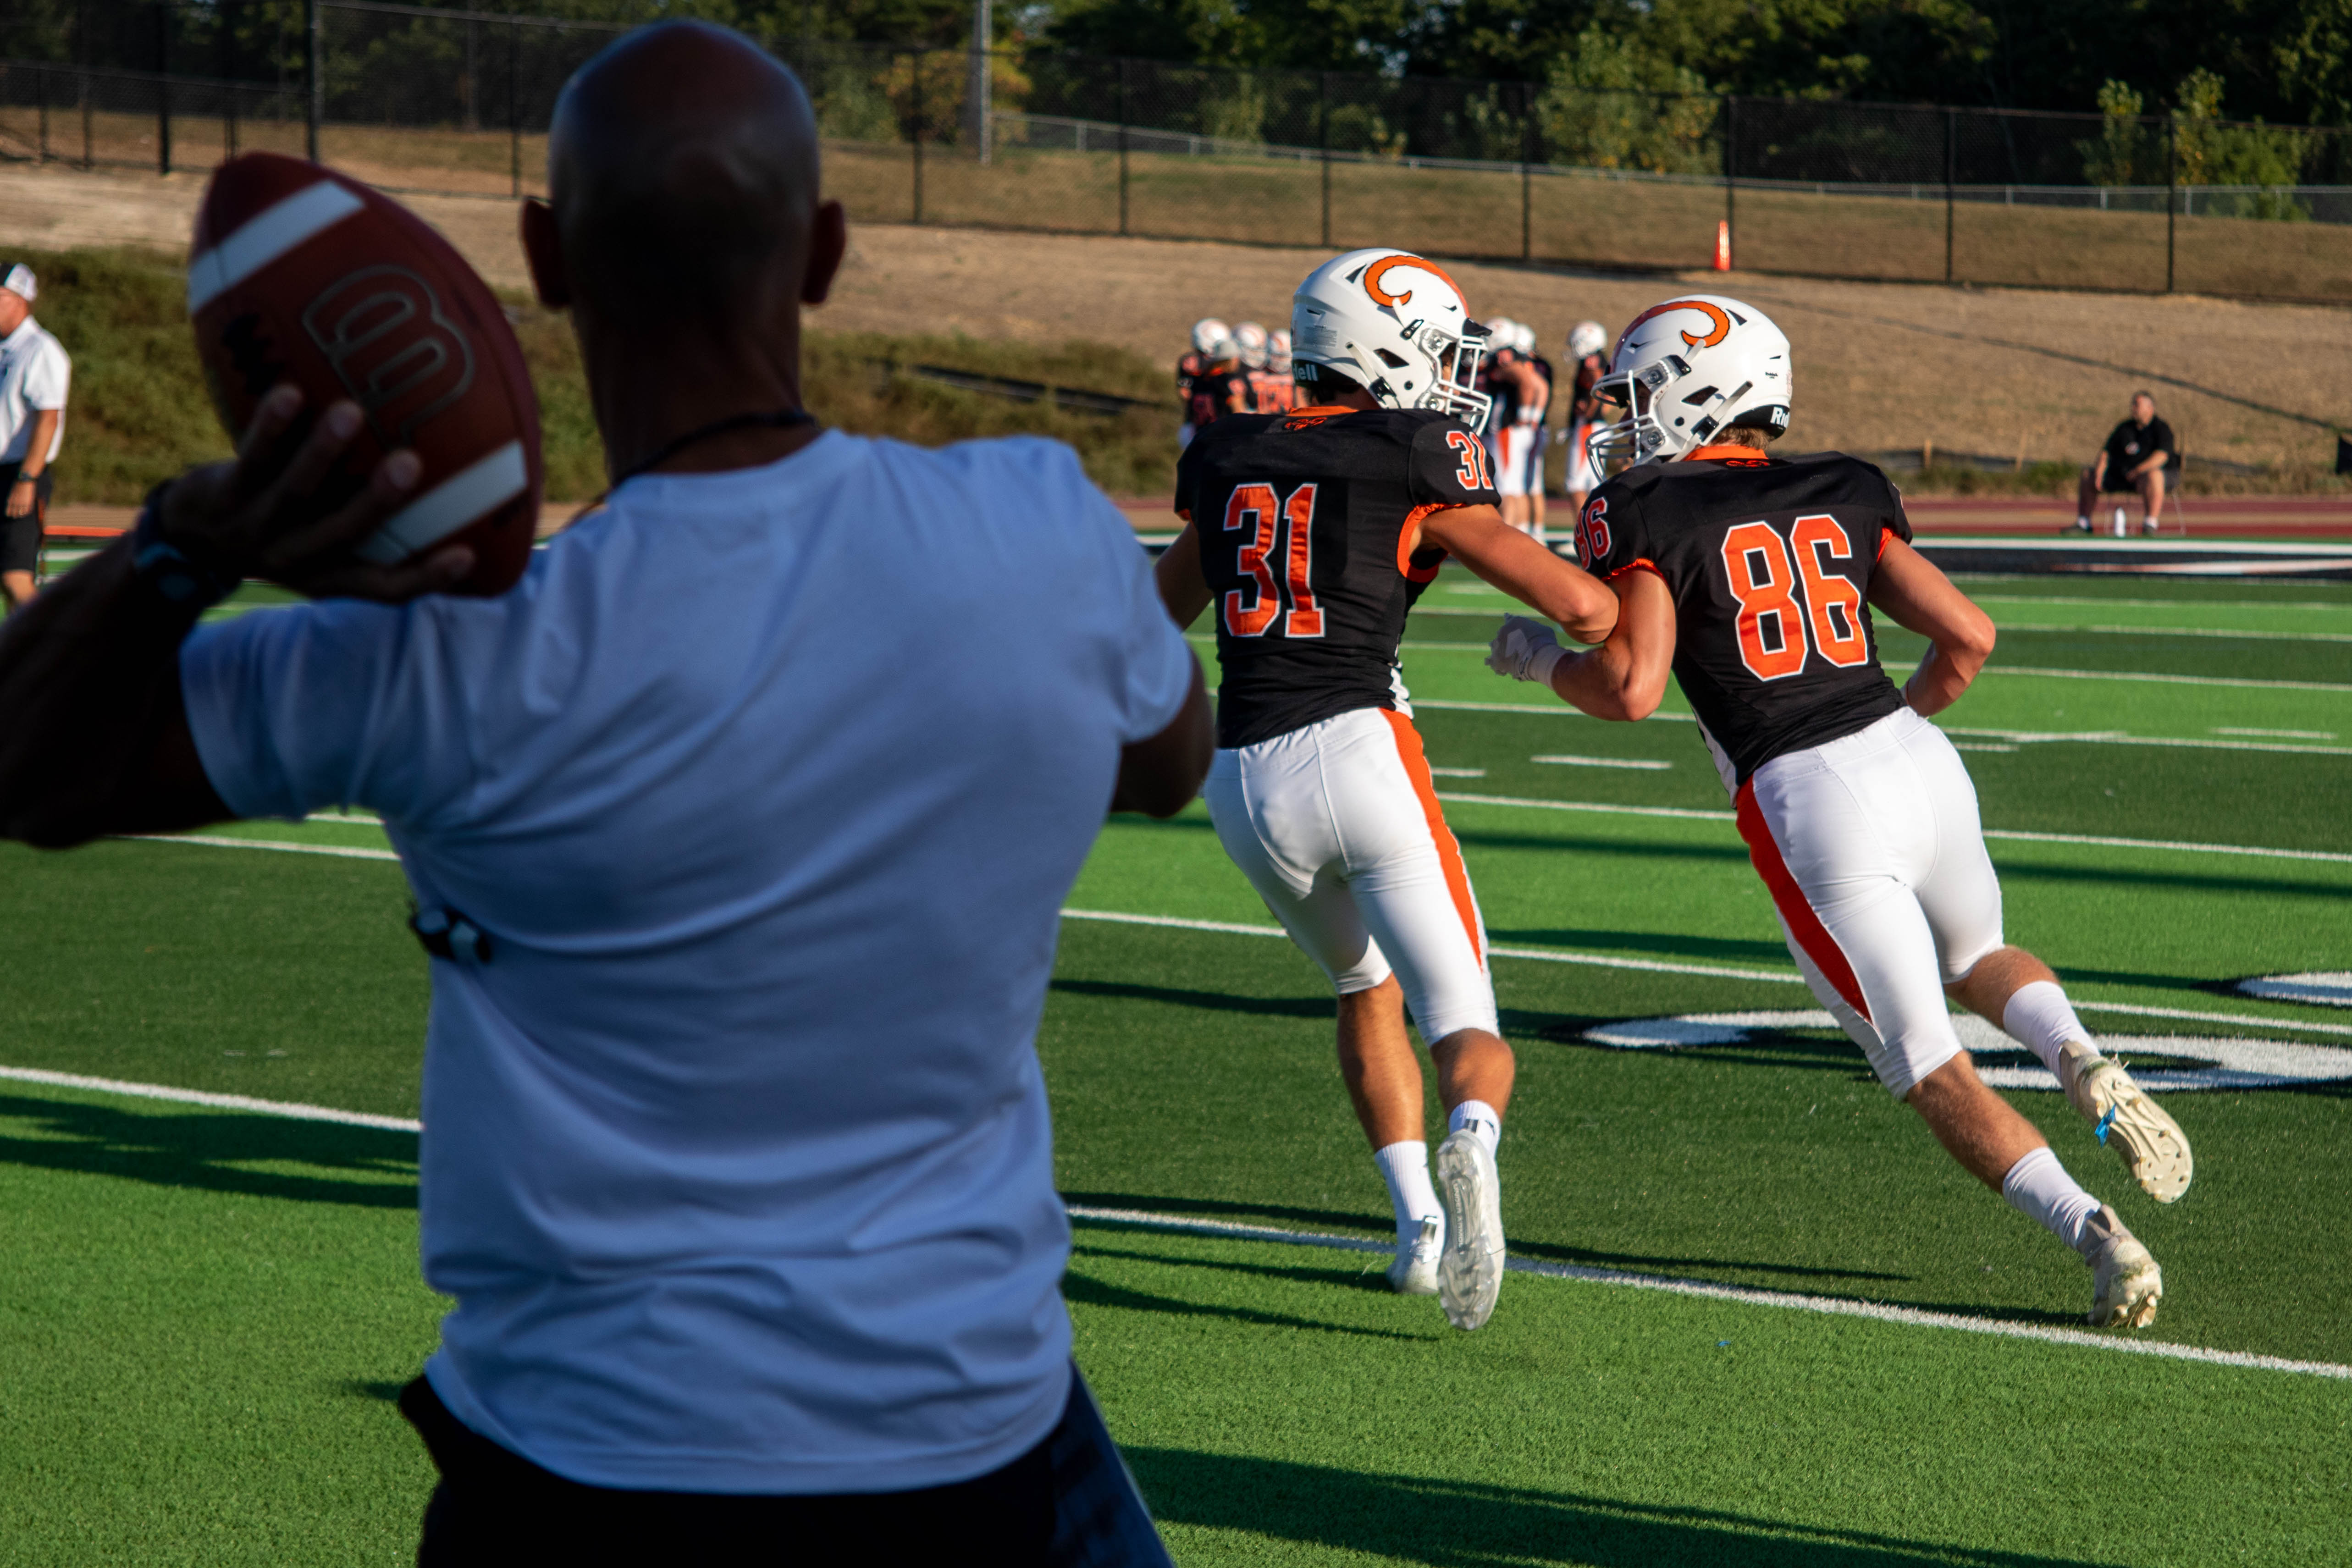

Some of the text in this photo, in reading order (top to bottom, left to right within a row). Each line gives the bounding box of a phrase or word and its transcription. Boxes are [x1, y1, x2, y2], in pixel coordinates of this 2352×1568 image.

[1446, 431, 1494, 490] 31
[1223, 482, 1325, 638] 31
[1574, 496, 1612, 571] 86
[1720, 513, 1869, 682] 86
